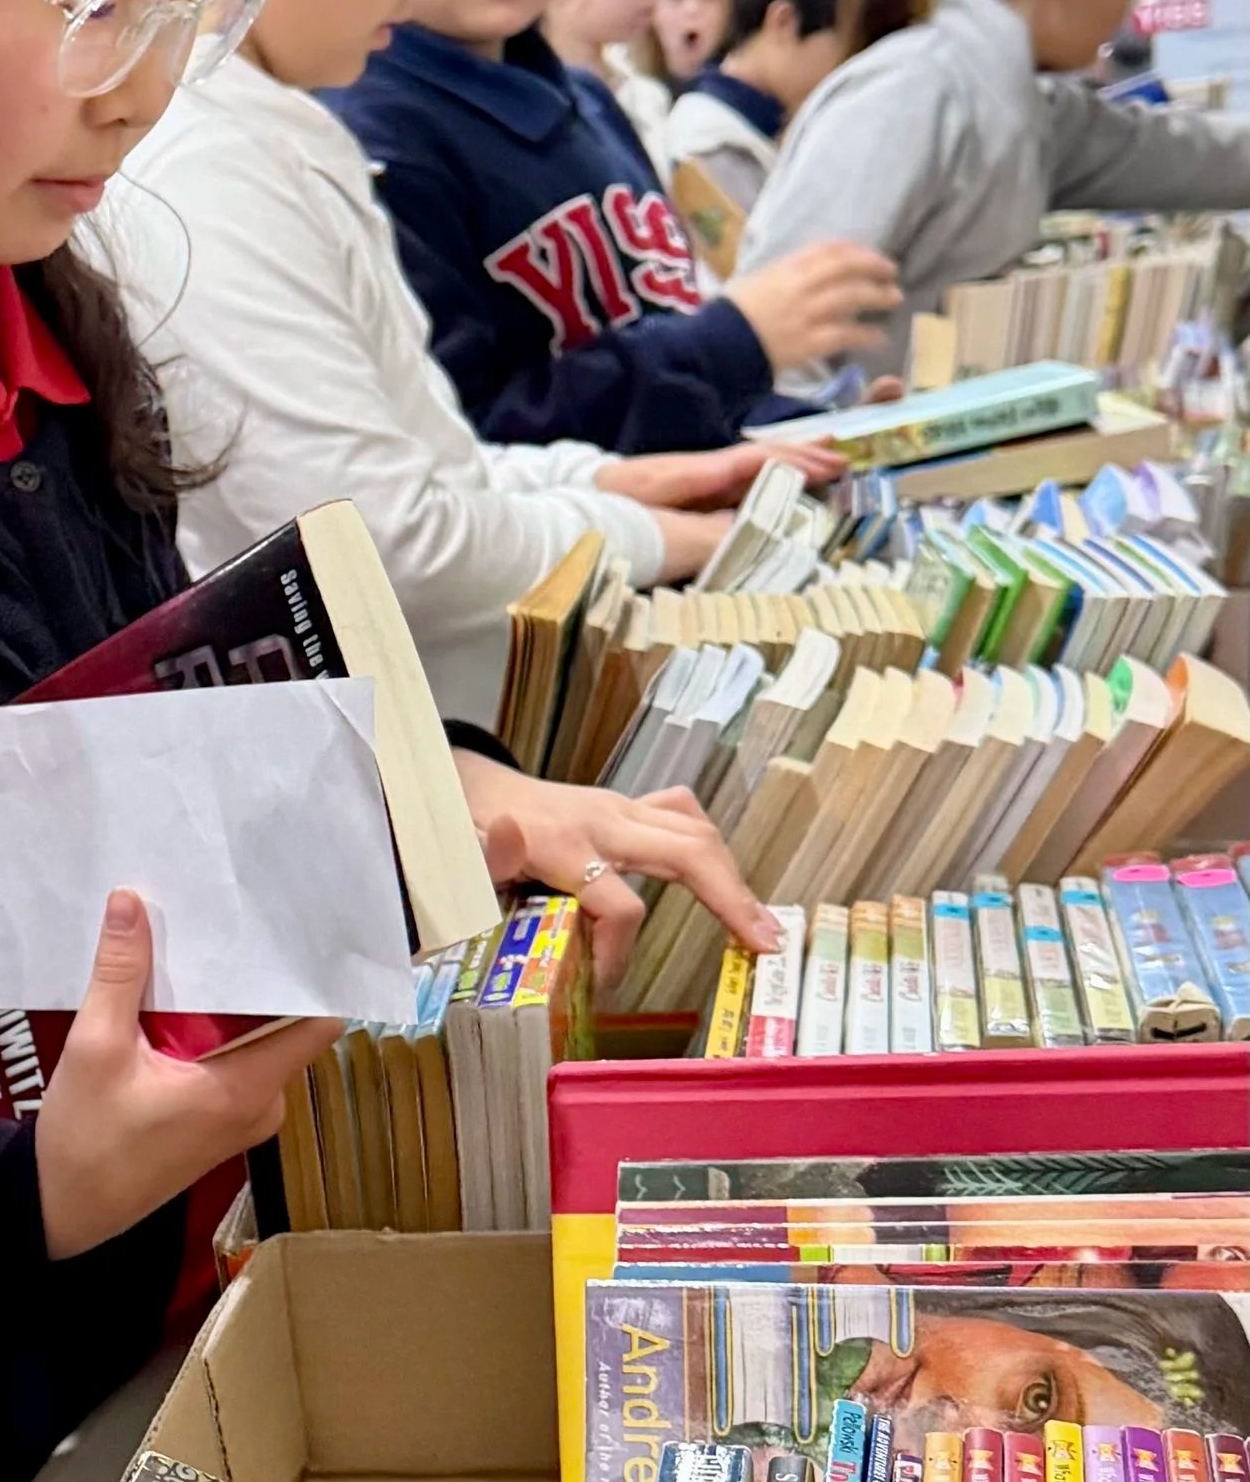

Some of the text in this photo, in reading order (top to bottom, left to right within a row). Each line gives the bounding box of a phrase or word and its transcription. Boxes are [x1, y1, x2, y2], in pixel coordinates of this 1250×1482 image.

[483, 182, 701, 358] YIS
[280, 569, 313, 635] Saving
[302, 634, 324, 668] the
[598, 1361, 612, 1417] Author
